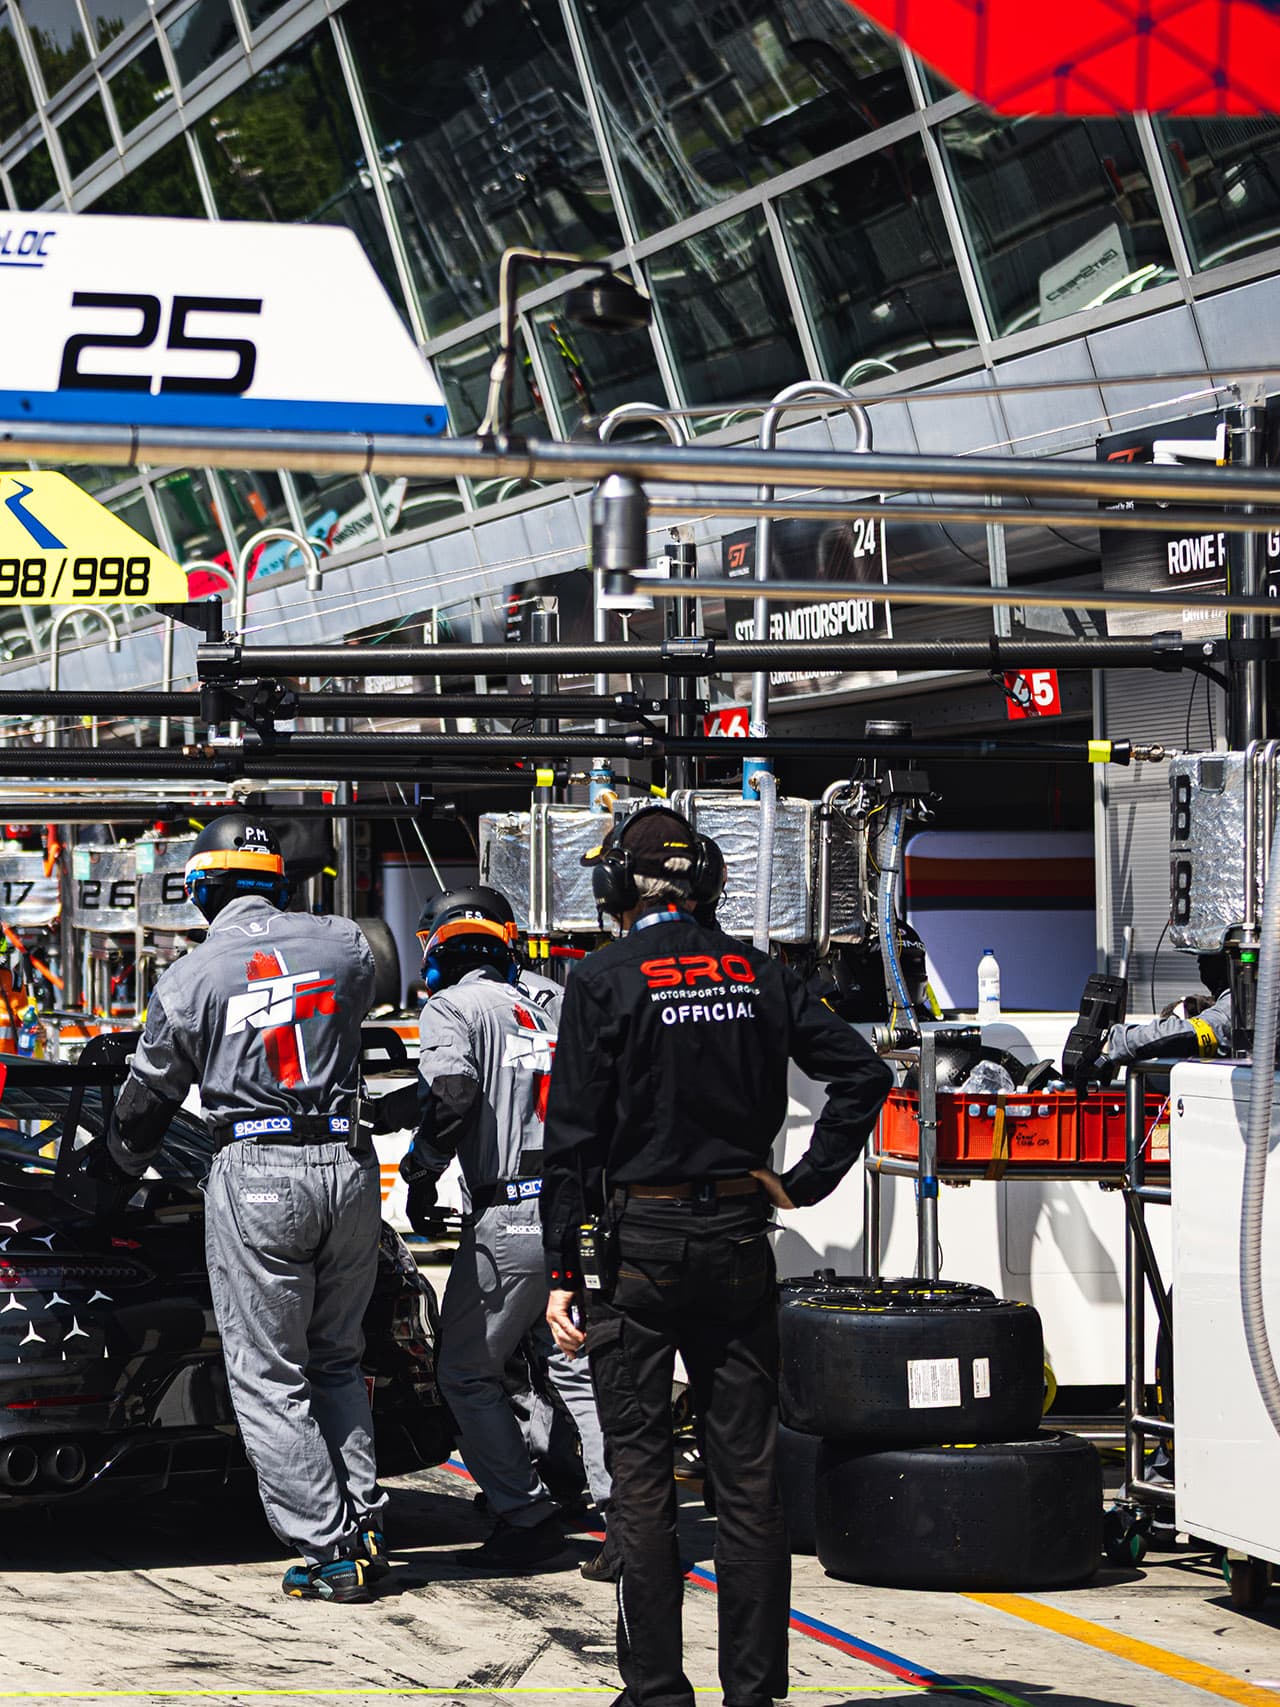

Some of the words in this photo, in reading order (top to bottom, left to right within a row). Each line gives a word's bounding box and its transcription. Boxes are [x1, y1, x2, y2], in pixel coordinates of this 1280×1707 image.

[57, 291, 263, 395] 25
[853, 517, 876, 558] 24
[1168, 534, 1216, 575] ROWE
[785, 599, 874, 640] MOTORSPORT
[640, 954, 756, 988] SRO
[650, 986, 726, 1002] MOTORSPORTS
[661, 1002, 756, 1025] OFFICIAL
[235, 1117, 291, 1134] sparco
